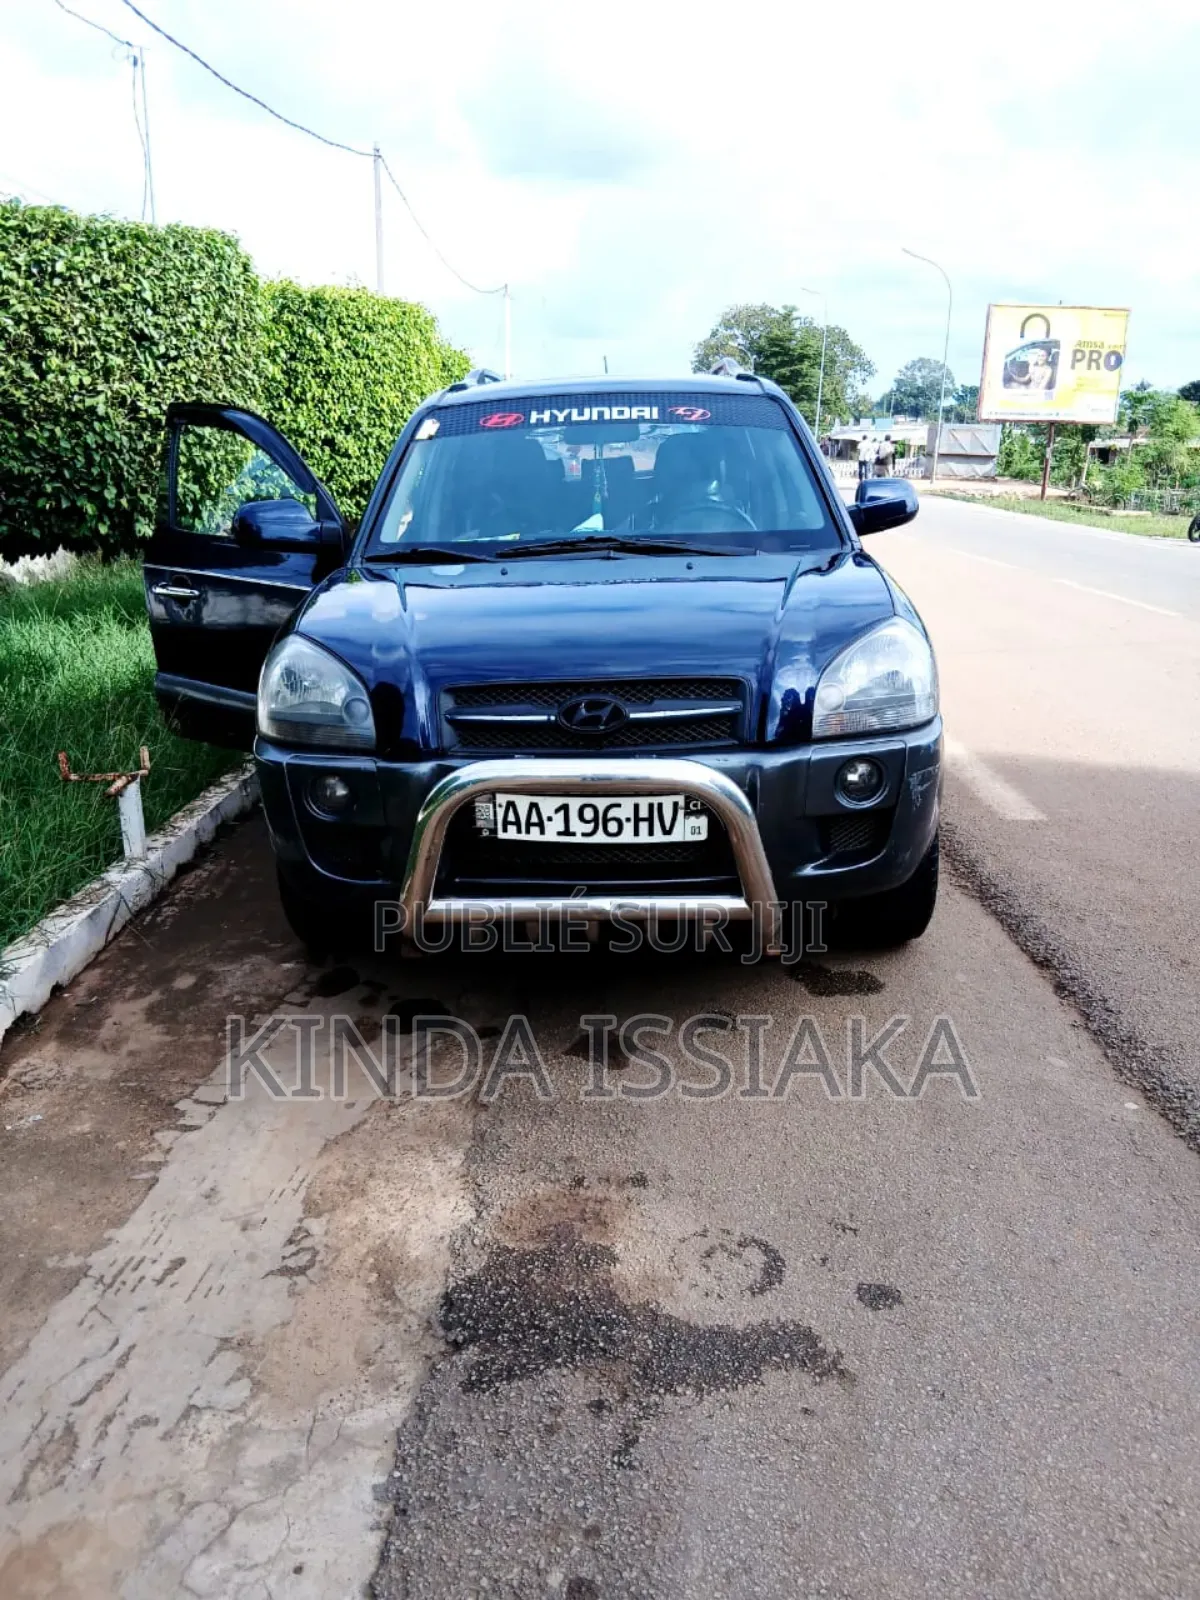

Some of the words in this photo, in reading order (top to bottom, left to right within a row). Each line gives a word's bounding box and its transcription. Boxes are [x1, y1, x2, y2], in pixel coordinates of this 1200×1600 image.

[1070, 349, 1123, 372] PRO
[529, 406, 659, 424] HYUNDAI
[691, 825, 702, 836] 01
